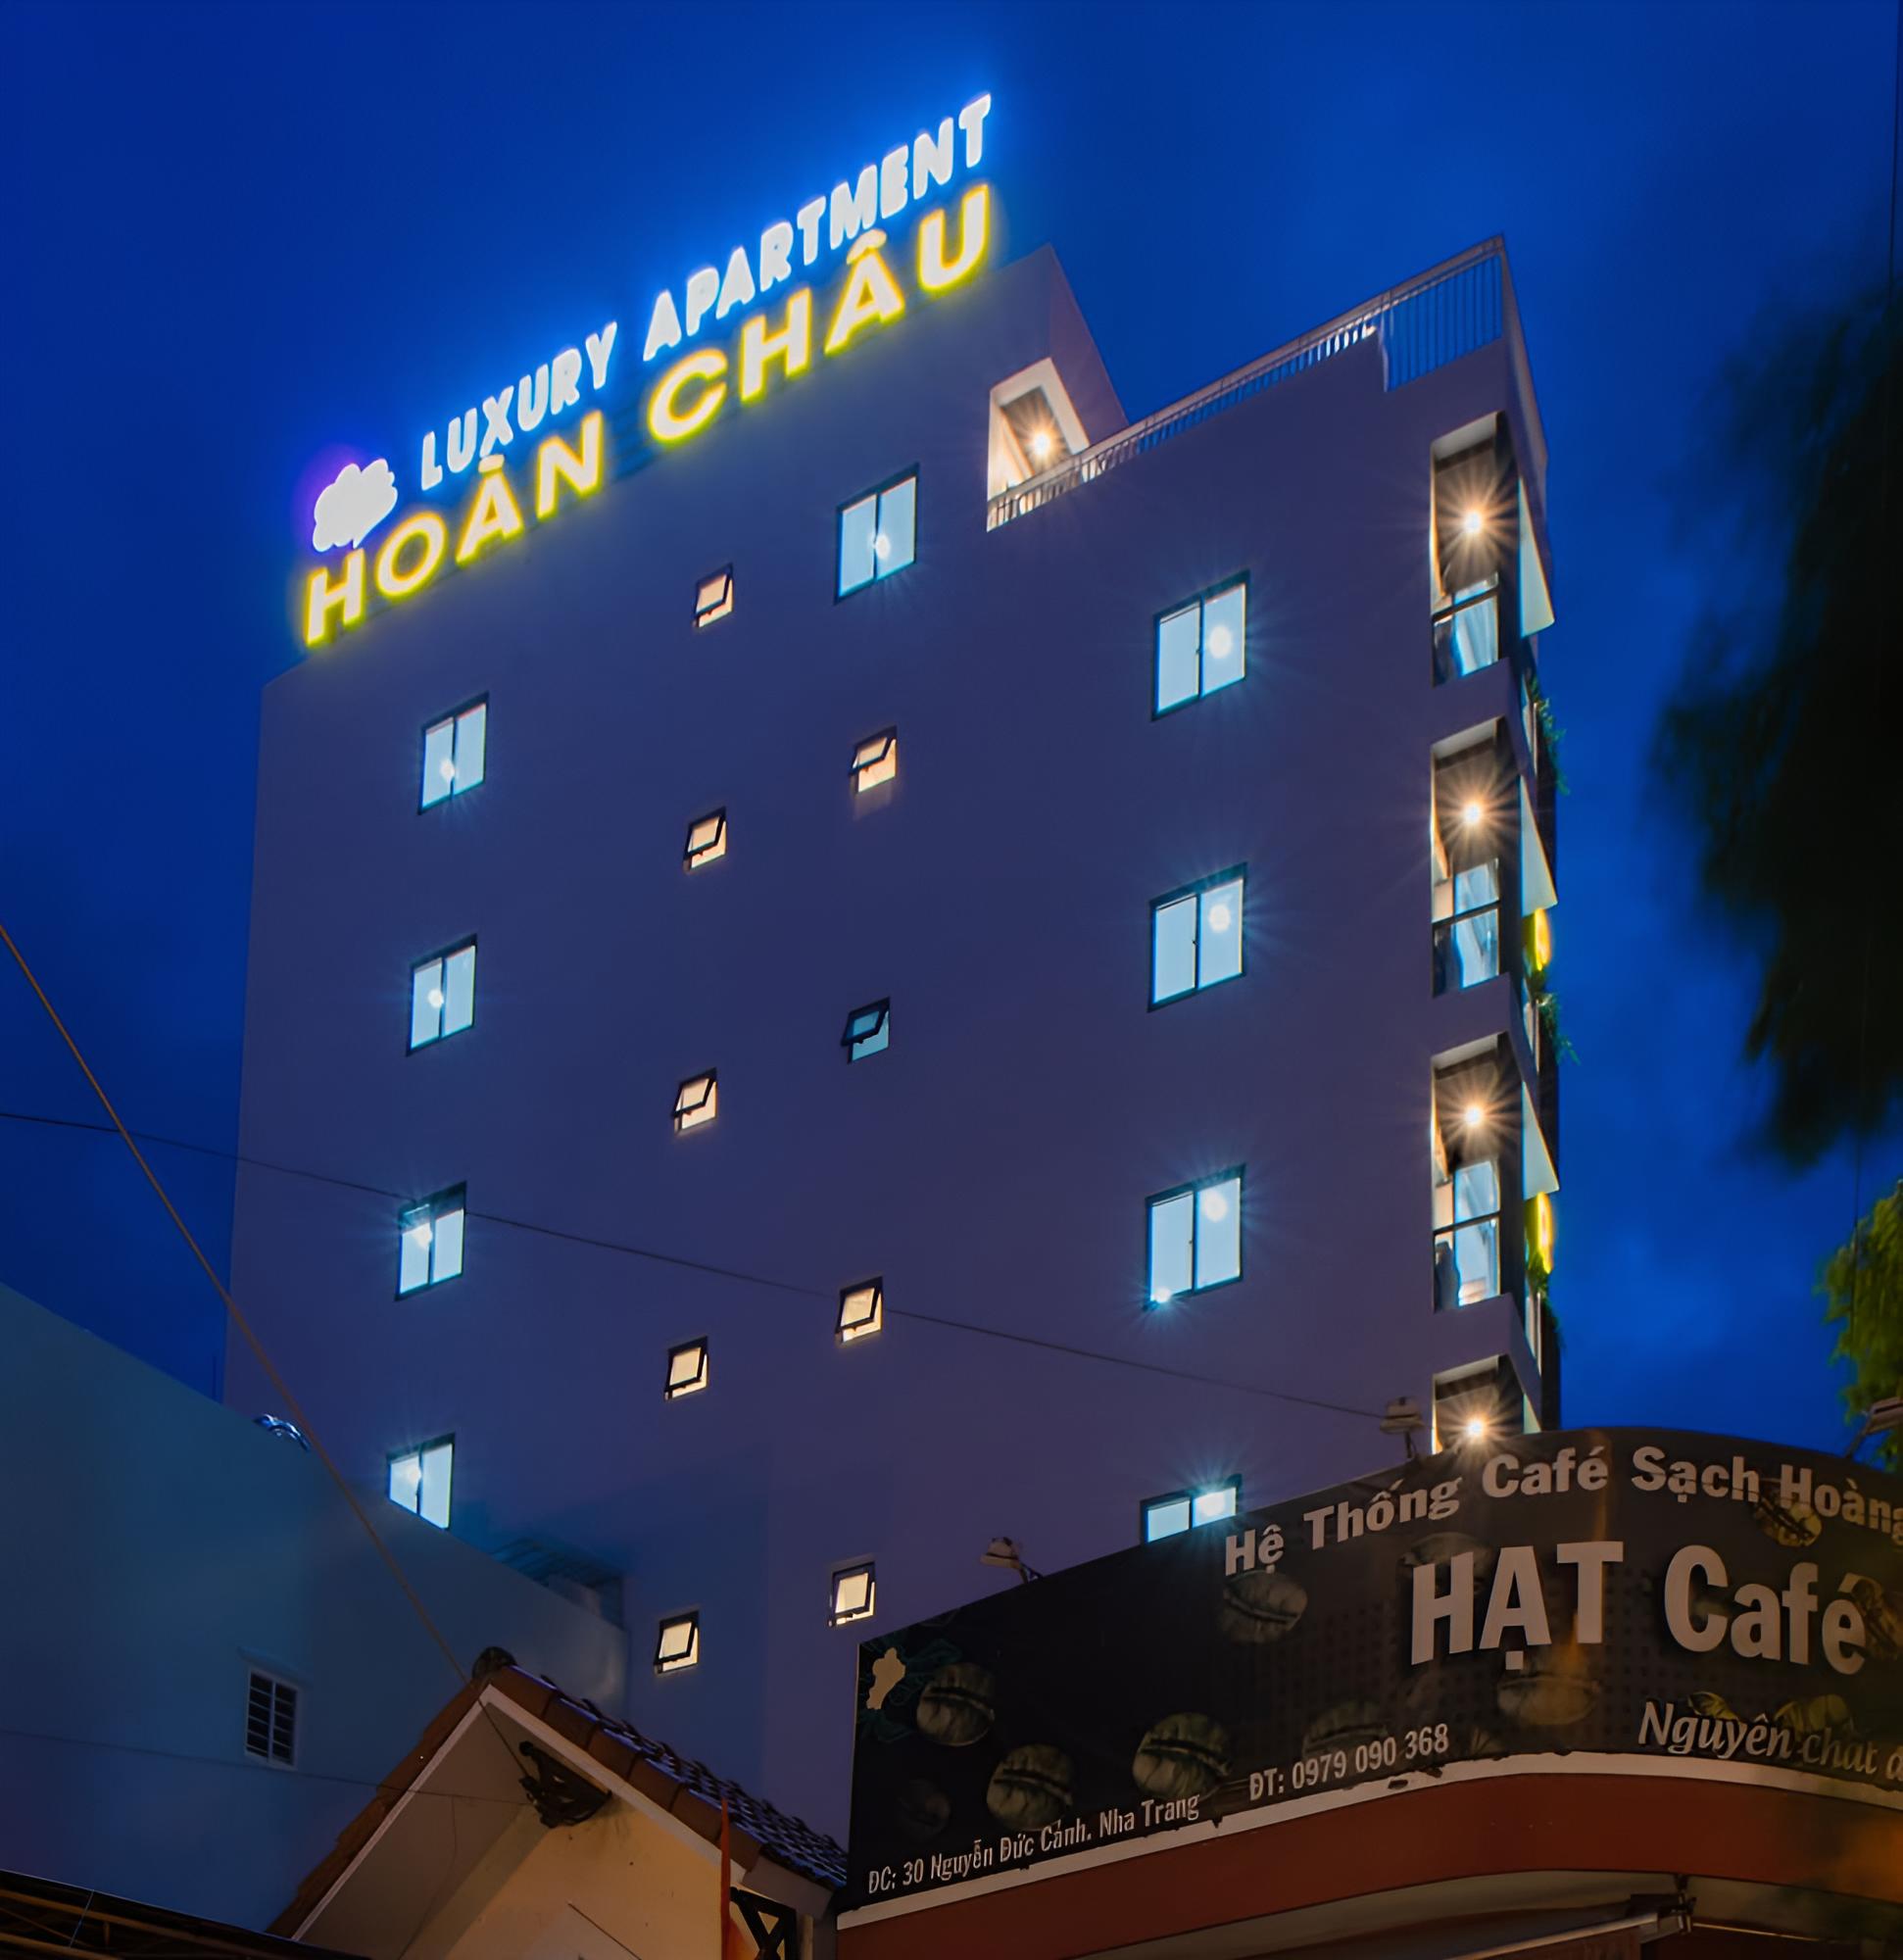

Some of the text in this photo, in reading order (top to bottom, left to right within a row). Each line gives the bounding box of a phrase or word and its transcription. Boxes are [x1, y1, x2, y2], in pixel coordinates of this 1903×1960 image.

[421, 94, 991, 490] LUXURY APARTMENT
[647, 183, 990, 446] CHÂU
[1225, 1524, 1285, 1576] Hệ
[1303, 1476, 1463, 1550] Thống
[1482, 1446, 1609, 1498] Café
[1631, 1446, 1760, 1503] Sạch
[1411, 1541, 1867, 1675] HẠT Café
[1292, 1750, 1347, 1789] 0979
[1355, 1737, 1396, 1773] 090
[1404, 1723, 1449, 1759] 368
[1637, 1700, 1792, 1759] Nguyên
[903, 1859, 924, 1886] 30
[1099, 1811, 1135, 1838] Nha
[1141, 1794, 1201, 1827] Trang
